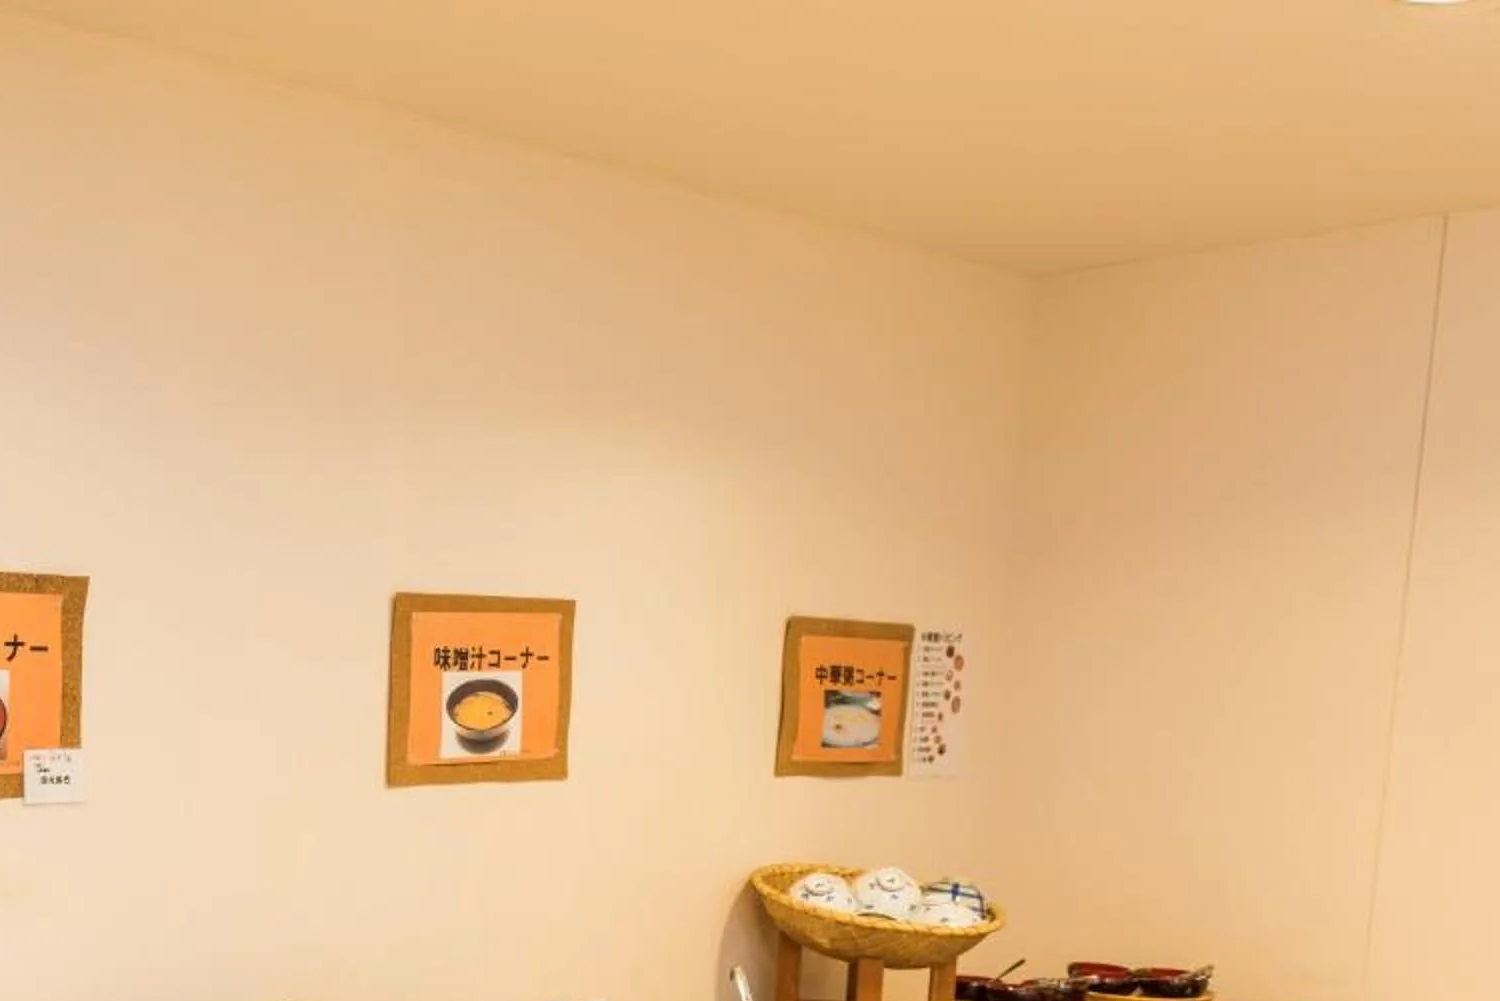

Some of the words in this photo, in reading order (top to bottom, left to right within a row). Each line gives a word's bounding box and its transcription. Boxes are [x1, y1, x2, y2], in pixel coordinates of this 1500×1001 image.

[433, 645, 550, 672] 味噌汁コーナー
